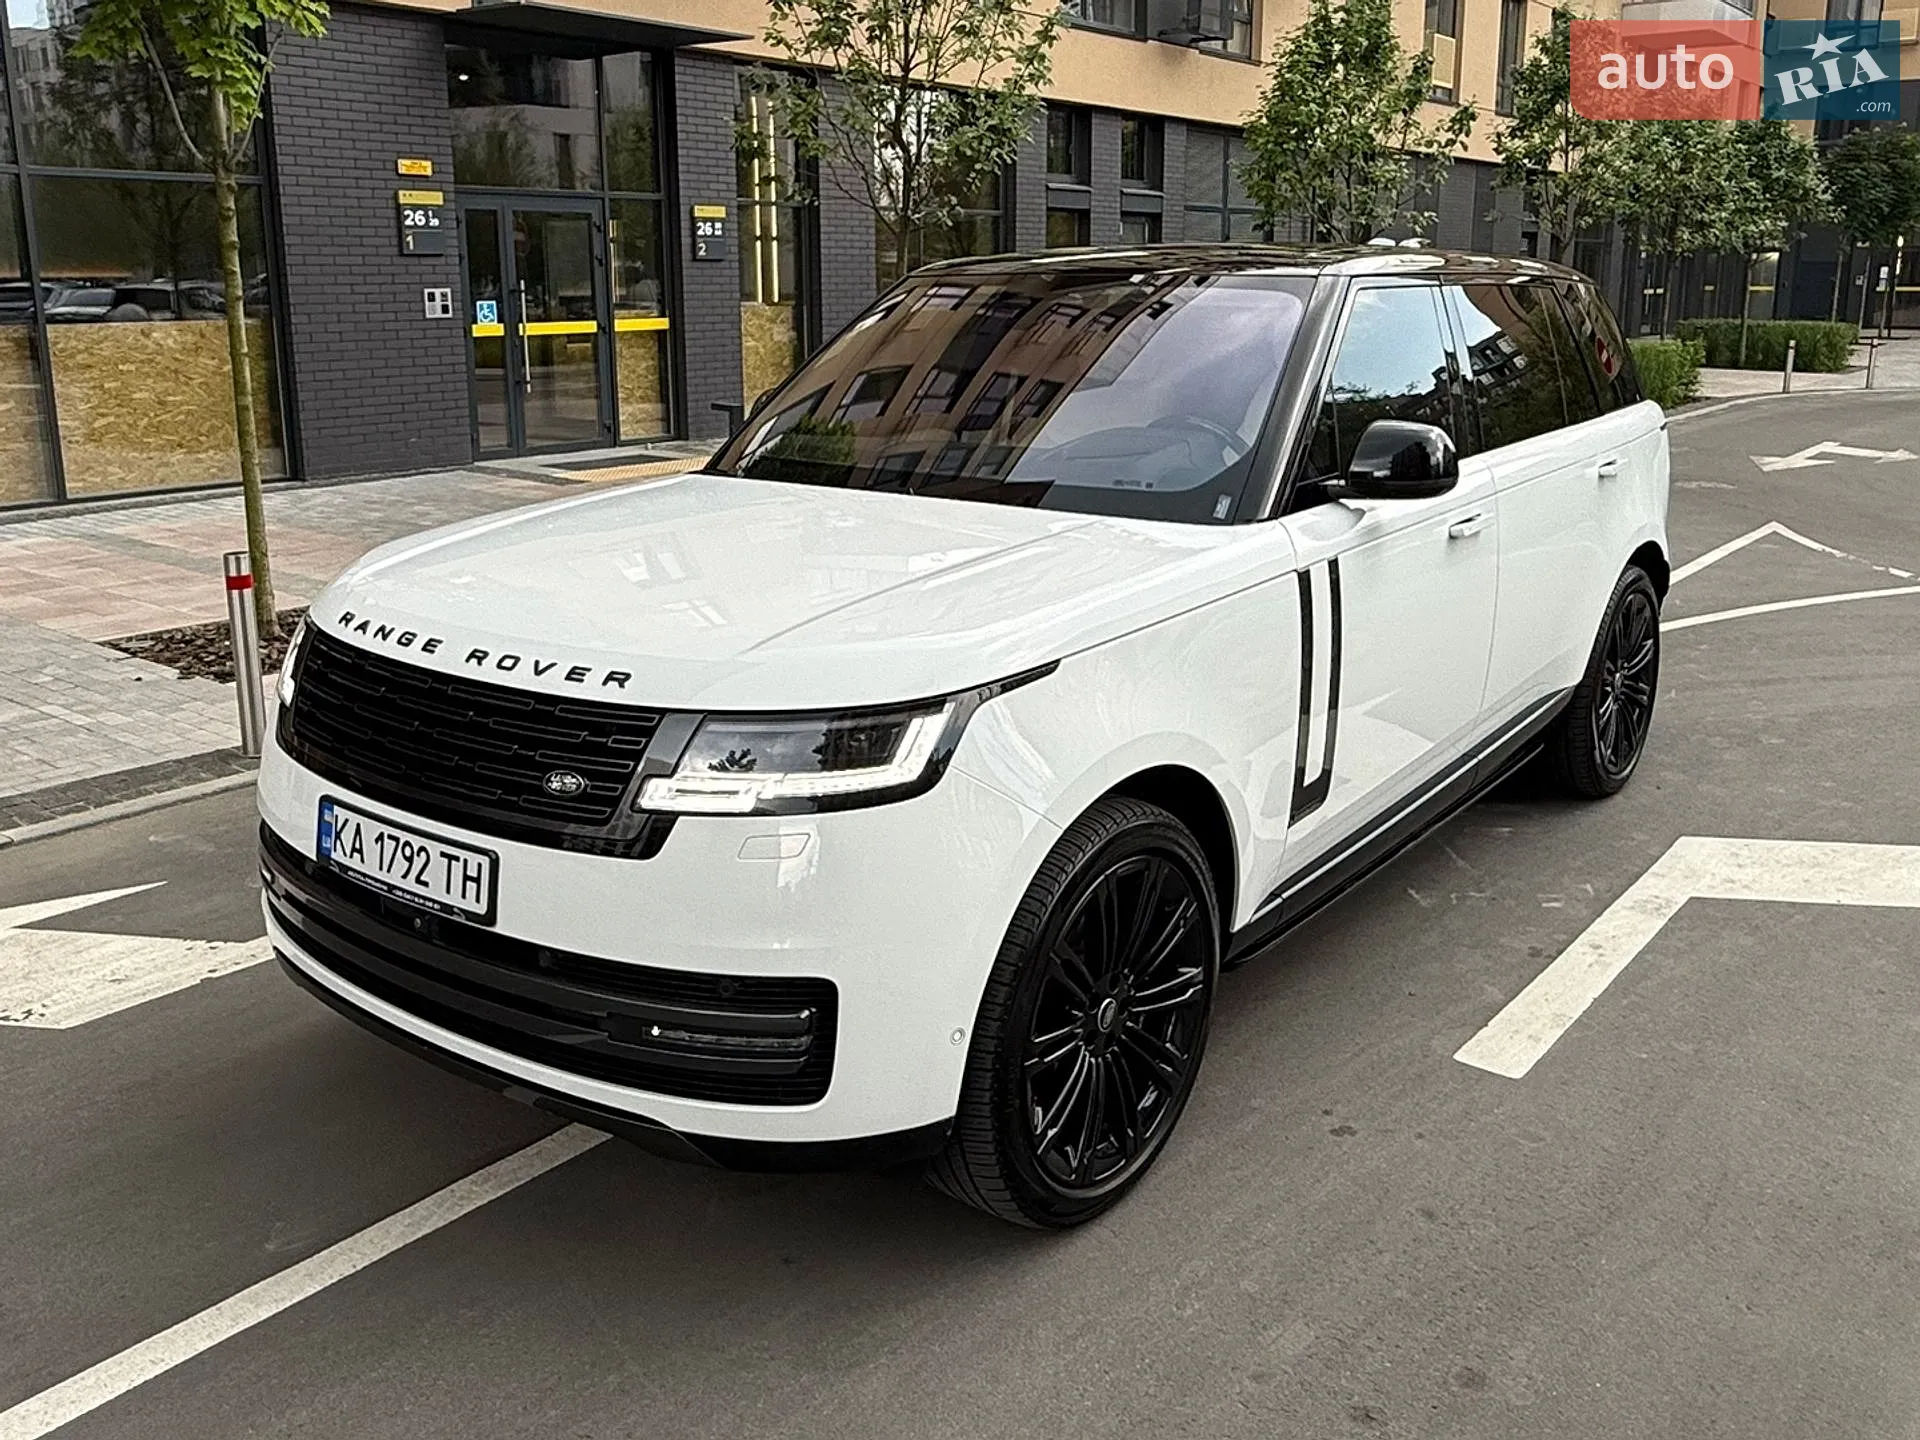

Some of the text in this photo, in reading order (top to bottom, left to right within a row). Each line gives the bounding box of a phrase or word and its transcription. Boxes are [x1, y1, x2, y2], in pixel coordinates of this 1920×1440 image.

[403, 209, 427, 226] 26
[696, 221, 713, 236] 26
[406, 234, 414, 251] 1
[698, 242, 707, 256] 2
[338, 611, 633, 689] RANGE ROVER
[333, 814, 365, 864] KA
[374, 831, 430, 888] 1792
[440, 850, 483, 904] TH
